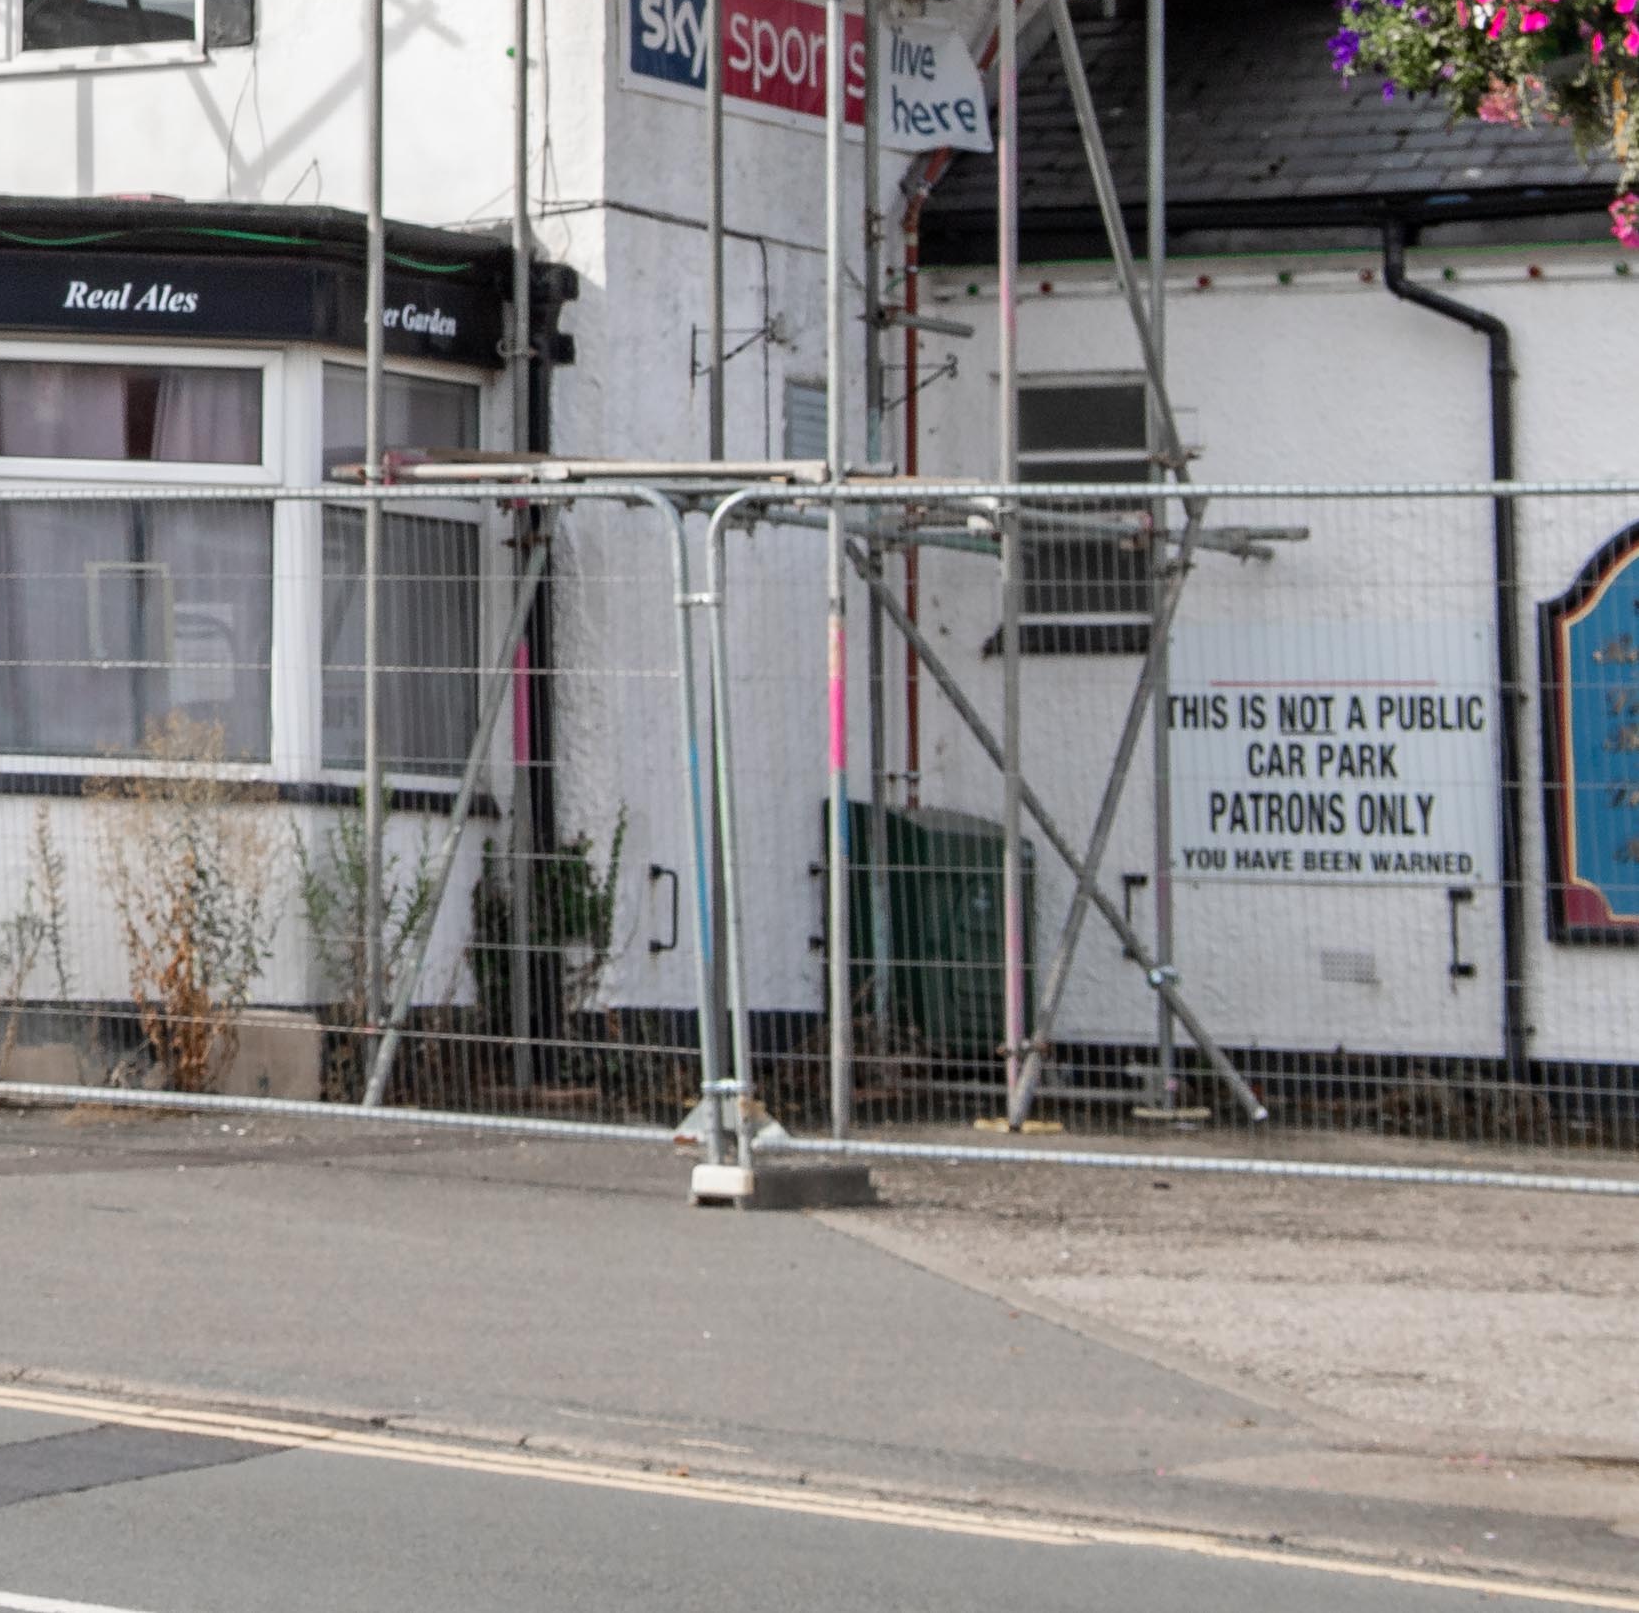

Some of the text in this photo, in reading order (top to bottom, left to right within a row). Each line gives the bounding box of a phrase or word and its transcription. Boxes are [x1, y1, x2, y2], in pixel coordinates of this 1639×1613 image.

[728, 11, 866, 99] spors
[890, 25, 936, 81] live
[892, 86, 977, 135] here
[63, 280, 199, 313] Real Ales
[401, 303, 457, 337] Garden
[1168, 695, 1484, 732] THIS IS NOT A PUBLIC
[1247, 742, 1398, 779] CAR PARK
[1210, 792, 1434, 836] PATRONS ONLY
[1182, 848, 1226, 872] YOU
[1235, 850, 1292, 872] HAVE
[1303, 851, 1362, 874] BEEN
